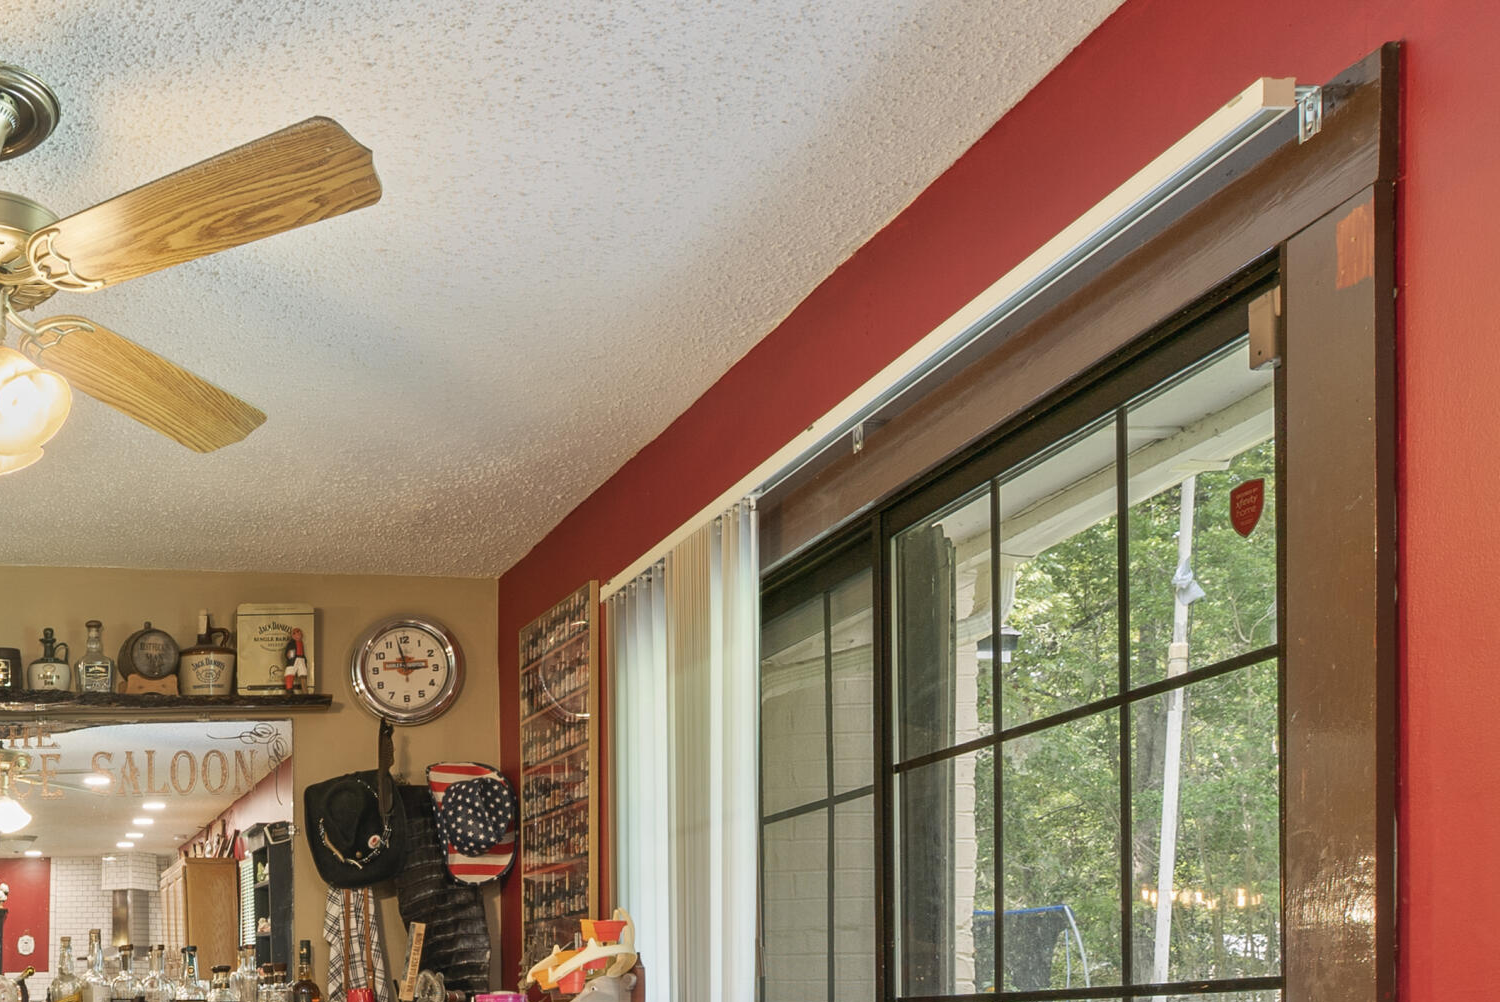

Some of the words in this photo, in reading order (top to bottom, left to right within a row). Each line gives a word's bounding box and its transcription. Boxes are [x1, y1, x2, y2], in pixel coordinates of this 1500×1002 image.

[399, 636, 409, 644] 12
[375, 652, 385, 660] 10
[427, 649, 434, 657] 2
[372, 667, 379, 675] 9
[432, 664, 439, 672] 3
[388, 692, 395, 700] 7
[418, 690, 425, 698] 5
[403, 695, 410, 703] 6
[91, 749, 259, 798] SALOON
